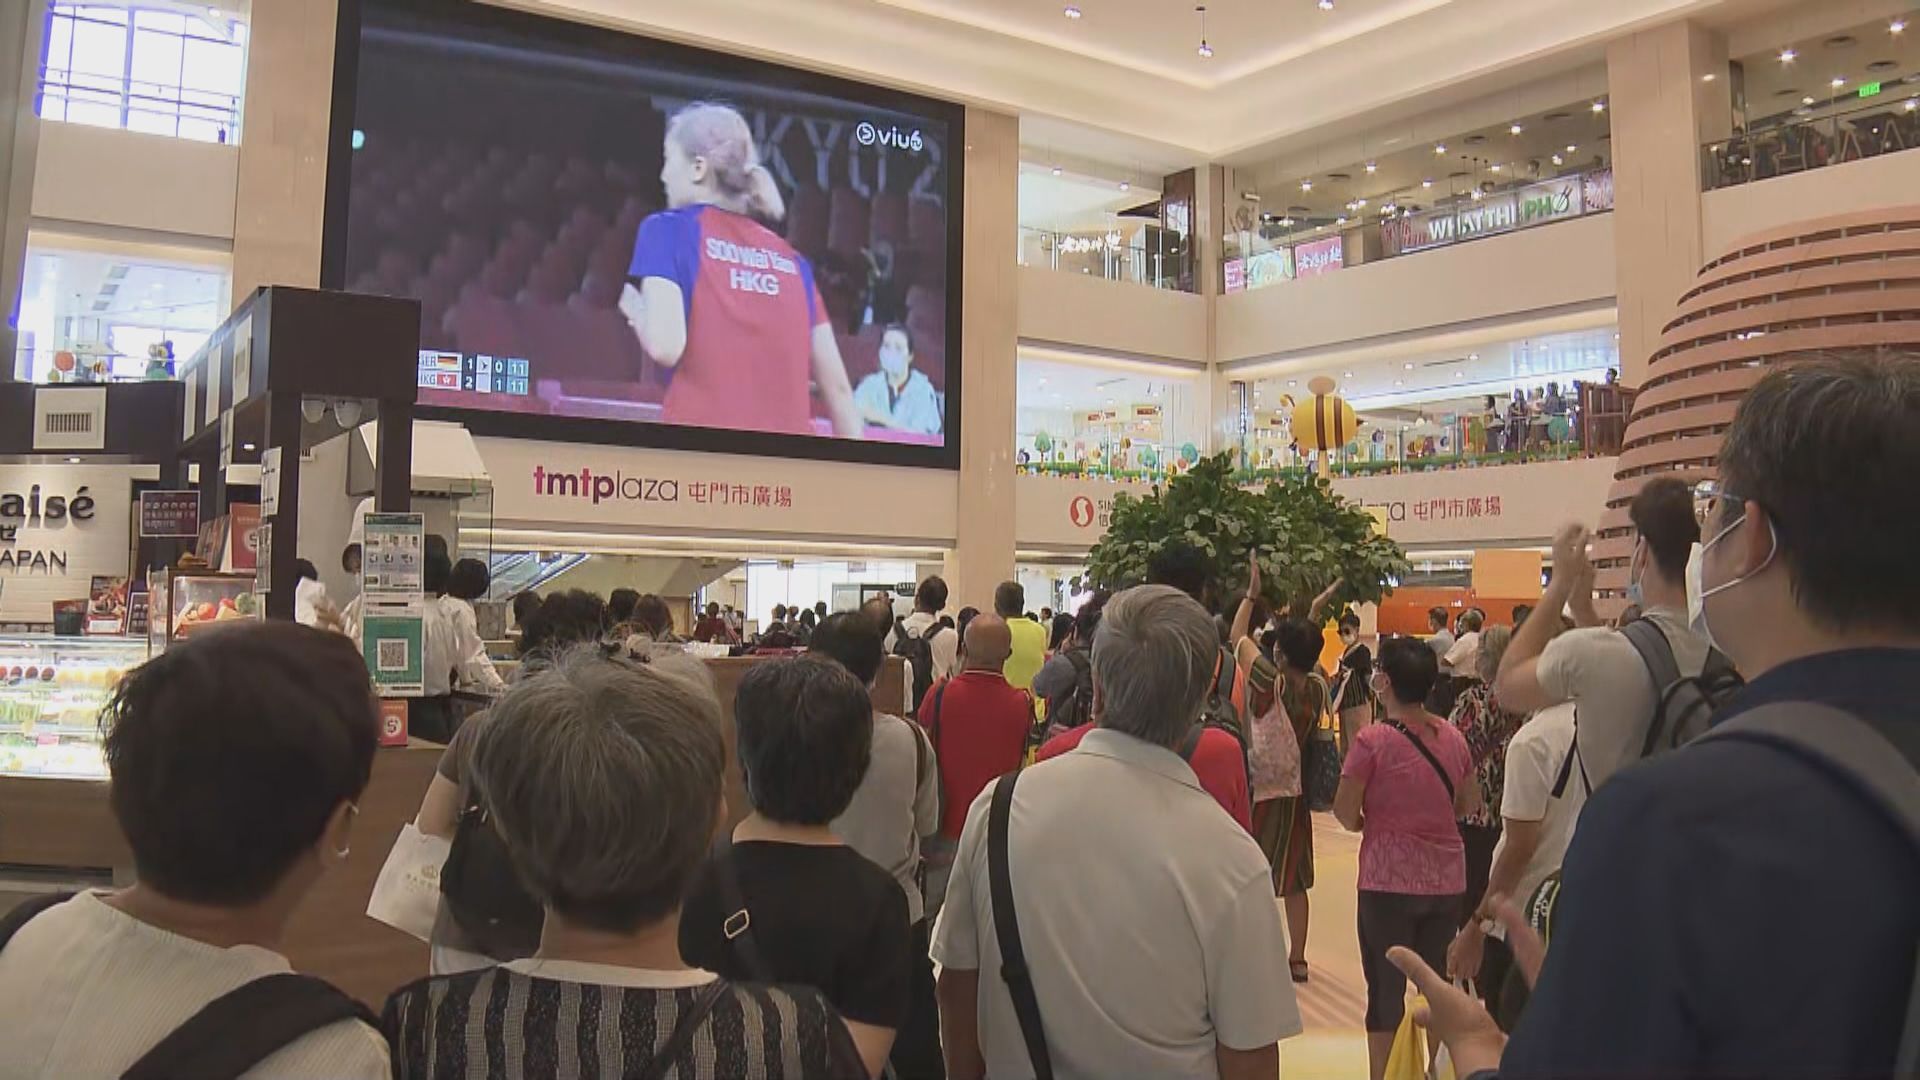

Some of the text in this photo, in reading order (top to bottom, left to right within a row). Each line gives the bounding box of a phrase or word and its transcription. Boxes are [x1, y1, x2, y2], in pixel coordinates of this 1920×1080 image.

[730, 268, 779, 296] HKG
[467, 358, 474, 371] 1
[495, 360, 503, 374] 0
[512, 363, 525, 376] 11
[465, 376, 473, 390] 2
[496, 378, 502, 392] 1
[511, 381, 524, 395] 11
[534, 466, 792, 508] tmtplaza 屯門市廣場
[0, 484, 95, 519] aisé
[1098, 499, 1115, 510] SIN
[1413, 496, 1501, 521] 屯門市廣場
[1099, 513, 1109, 527] 信
[0, 549, 67, 567] APAN
